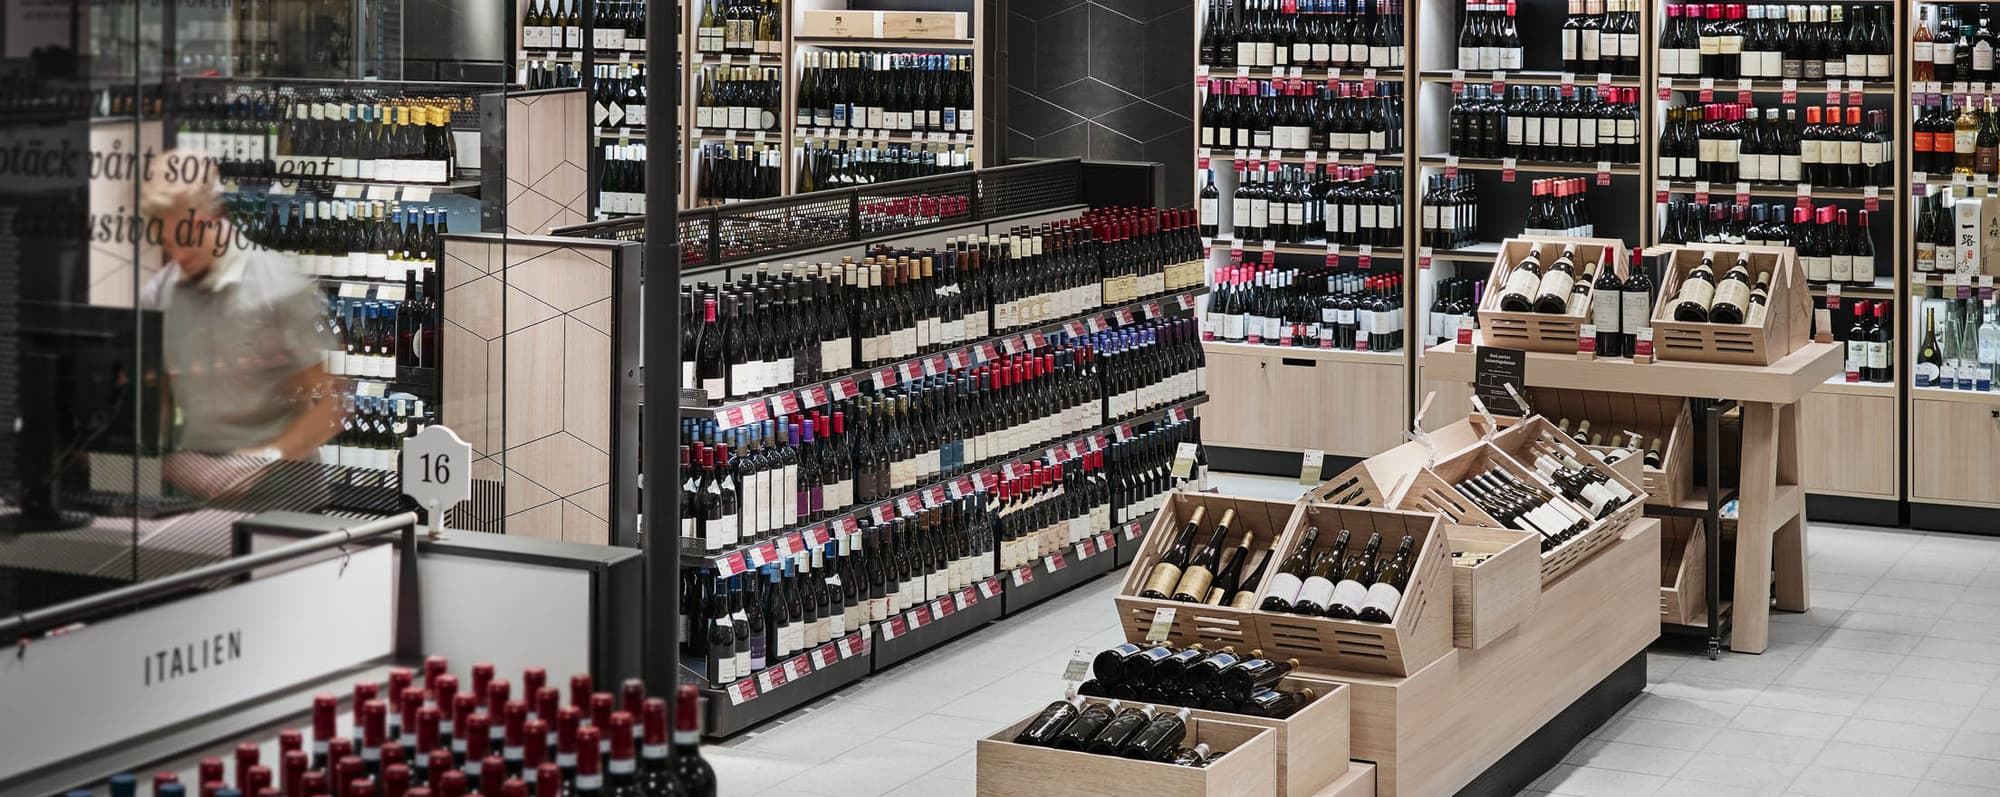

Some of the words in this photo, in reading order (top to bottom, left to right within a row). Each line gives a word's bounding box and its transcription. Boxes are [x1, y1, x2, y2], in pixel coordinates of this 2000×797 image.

[88, 138, 157, 183] vårt
[420, 453, 450, 484] 16
[144, 629, 242, 687] ITALIEN
